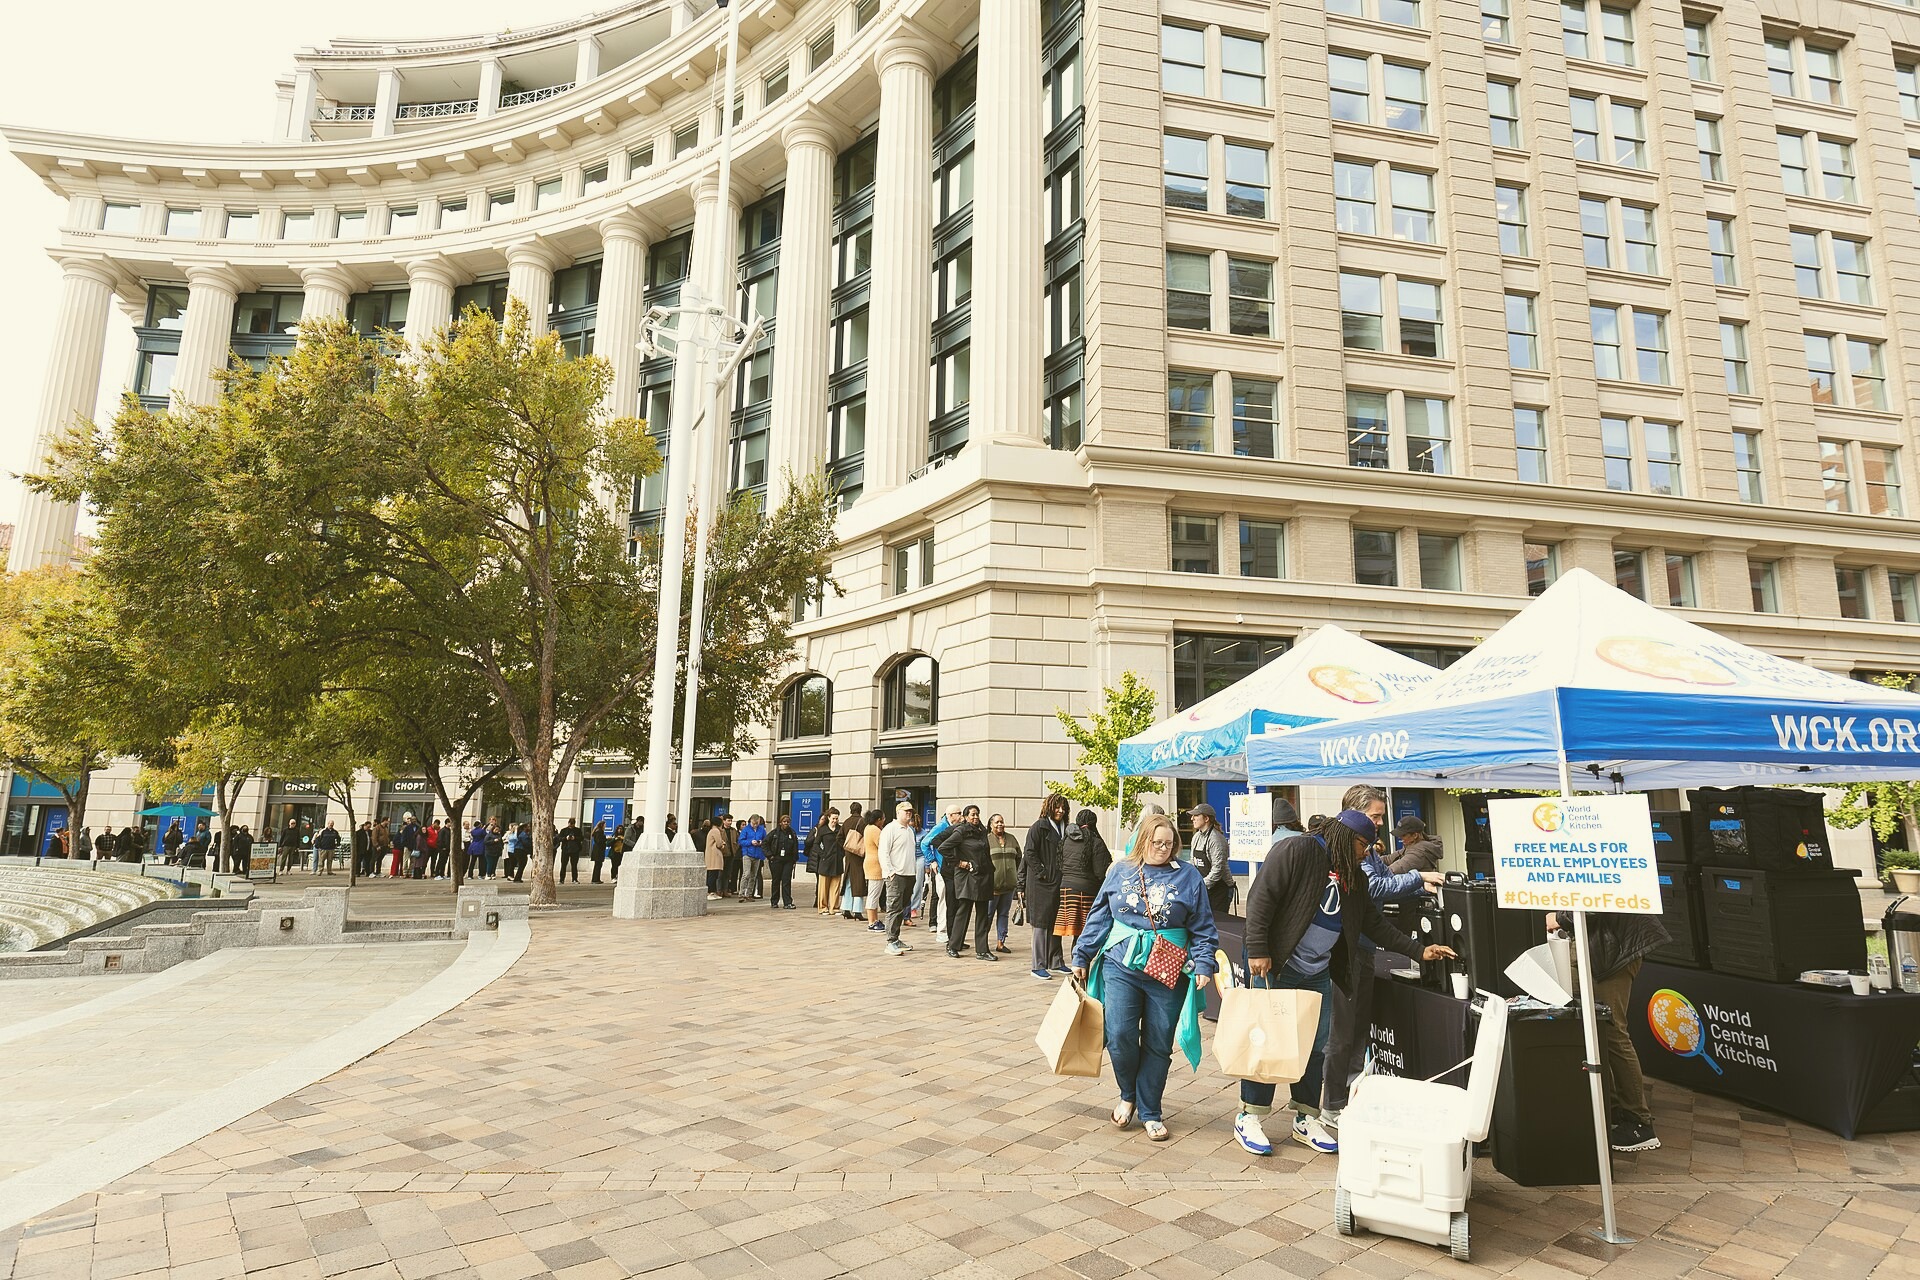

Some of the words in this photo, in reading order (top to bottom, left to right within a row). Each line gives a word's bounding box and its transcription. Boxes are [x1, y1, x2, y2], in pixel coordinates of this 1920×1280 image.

[1770, 714, 1920, 753] WCK.OR
[1320, 729, 1410, 767] WCK.ORG
[395, 782, 425, 791] CHOPT
[1567, 805, 1591, 813] World
[1569, 813, 1600, 821] Central
[1570, 822, 1603, 830] Kitchen
[1514, 843, 1547, 853] FREE
[1550, 842, 1597, 853] MEALS
[1600, 842, 1628, 853] FOR
[1501, 857, 1560, 868] FEDERAL
[1563, 857, 1648, 869] EMPLOYEES
[1527, 872, 1555, 883] AND
[1558, 872, 1622, 884] FAMILIES
[1504, 891, 1651, 909] #ChefsForFeds
[1703, 1003, 1752, 1028] World
[1710, 1023, 1770, 1051] Central
[1371, 1042, 1404, 1070] Central
[1714, 1042, 1777, 1072] Kitchen
